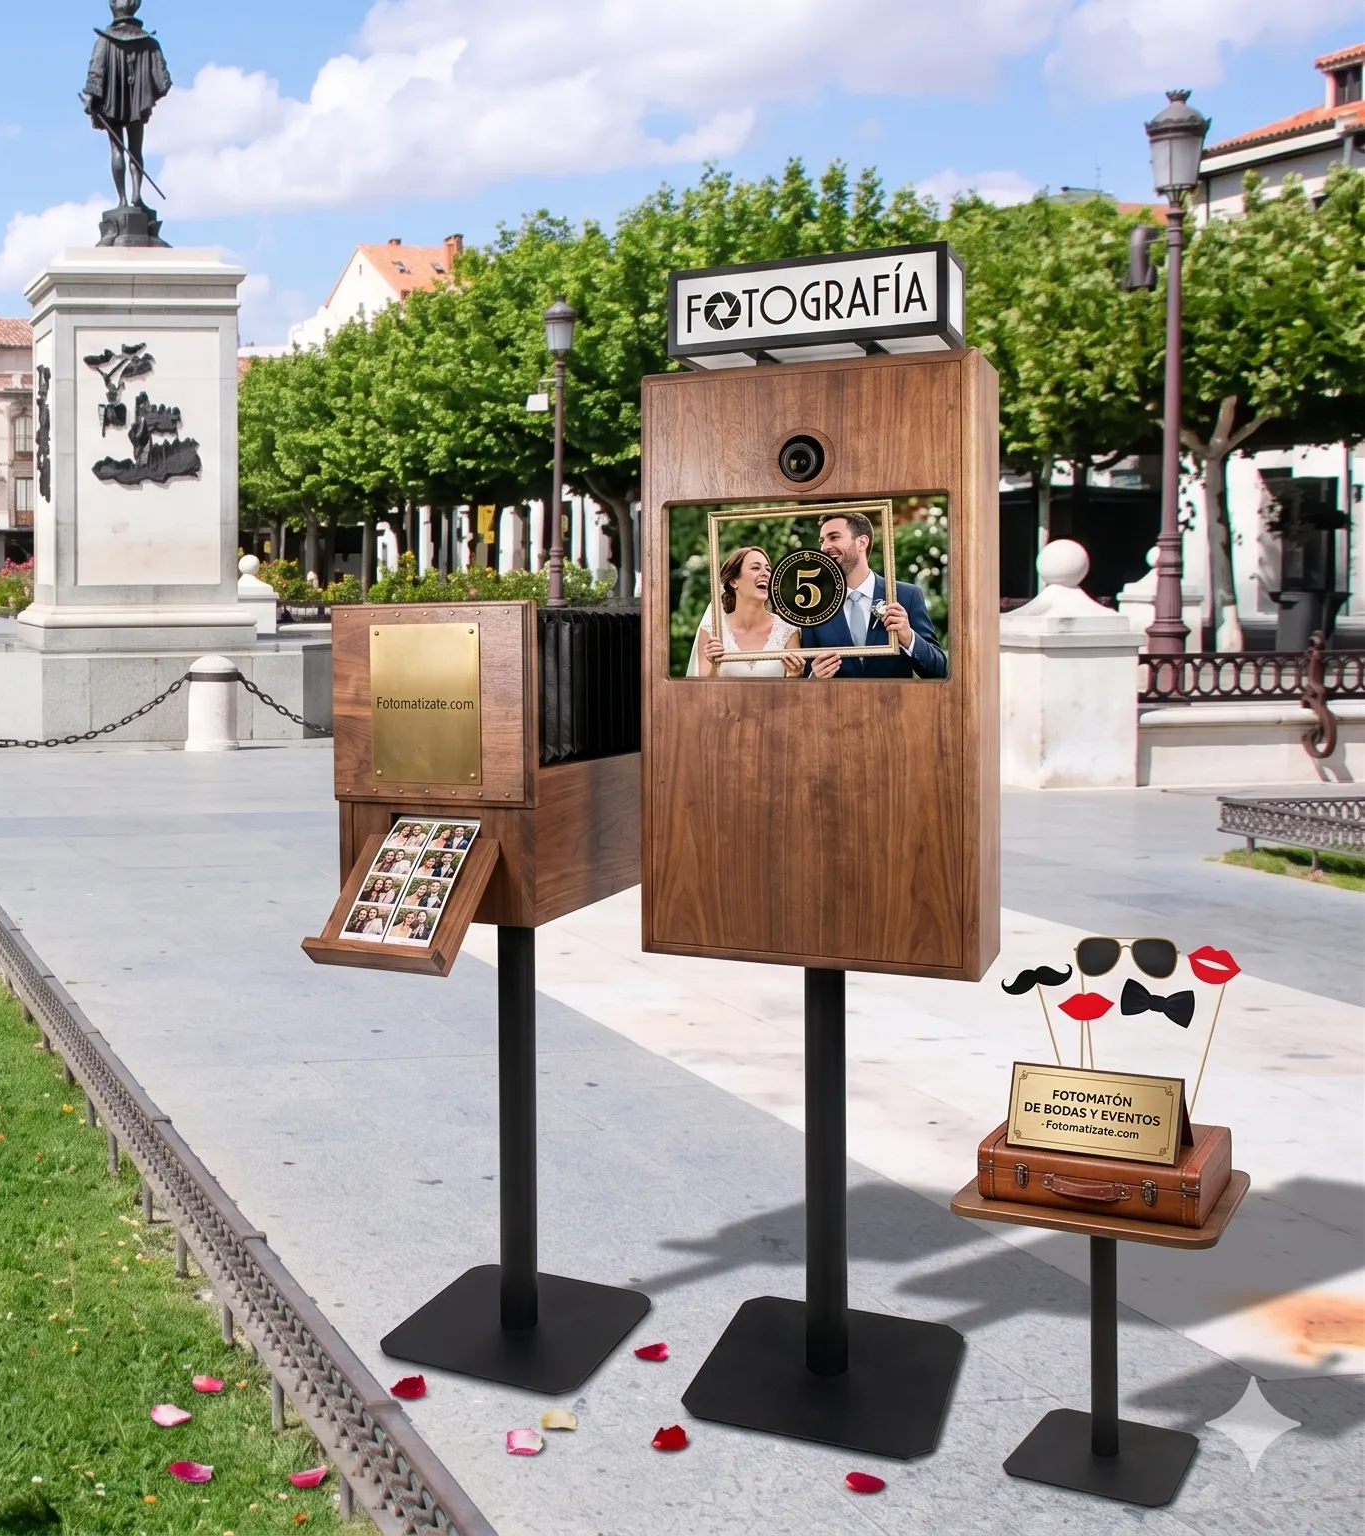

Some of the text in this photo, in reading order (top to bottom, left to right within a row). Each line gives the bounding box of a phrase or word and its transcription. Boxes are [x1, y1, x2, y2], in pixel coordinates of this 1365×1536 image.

[686, 262, 928, 333] FOTOGRAFÍA
[795, 567, 821, 608] 5
[376, 696, 474, 710] Fotomatizate.com
[1052, 1089, 1133, 1108] FOTOMATÓN
[1024, 1101, 1161, 1127] DE BODAS Y EVENTOS
